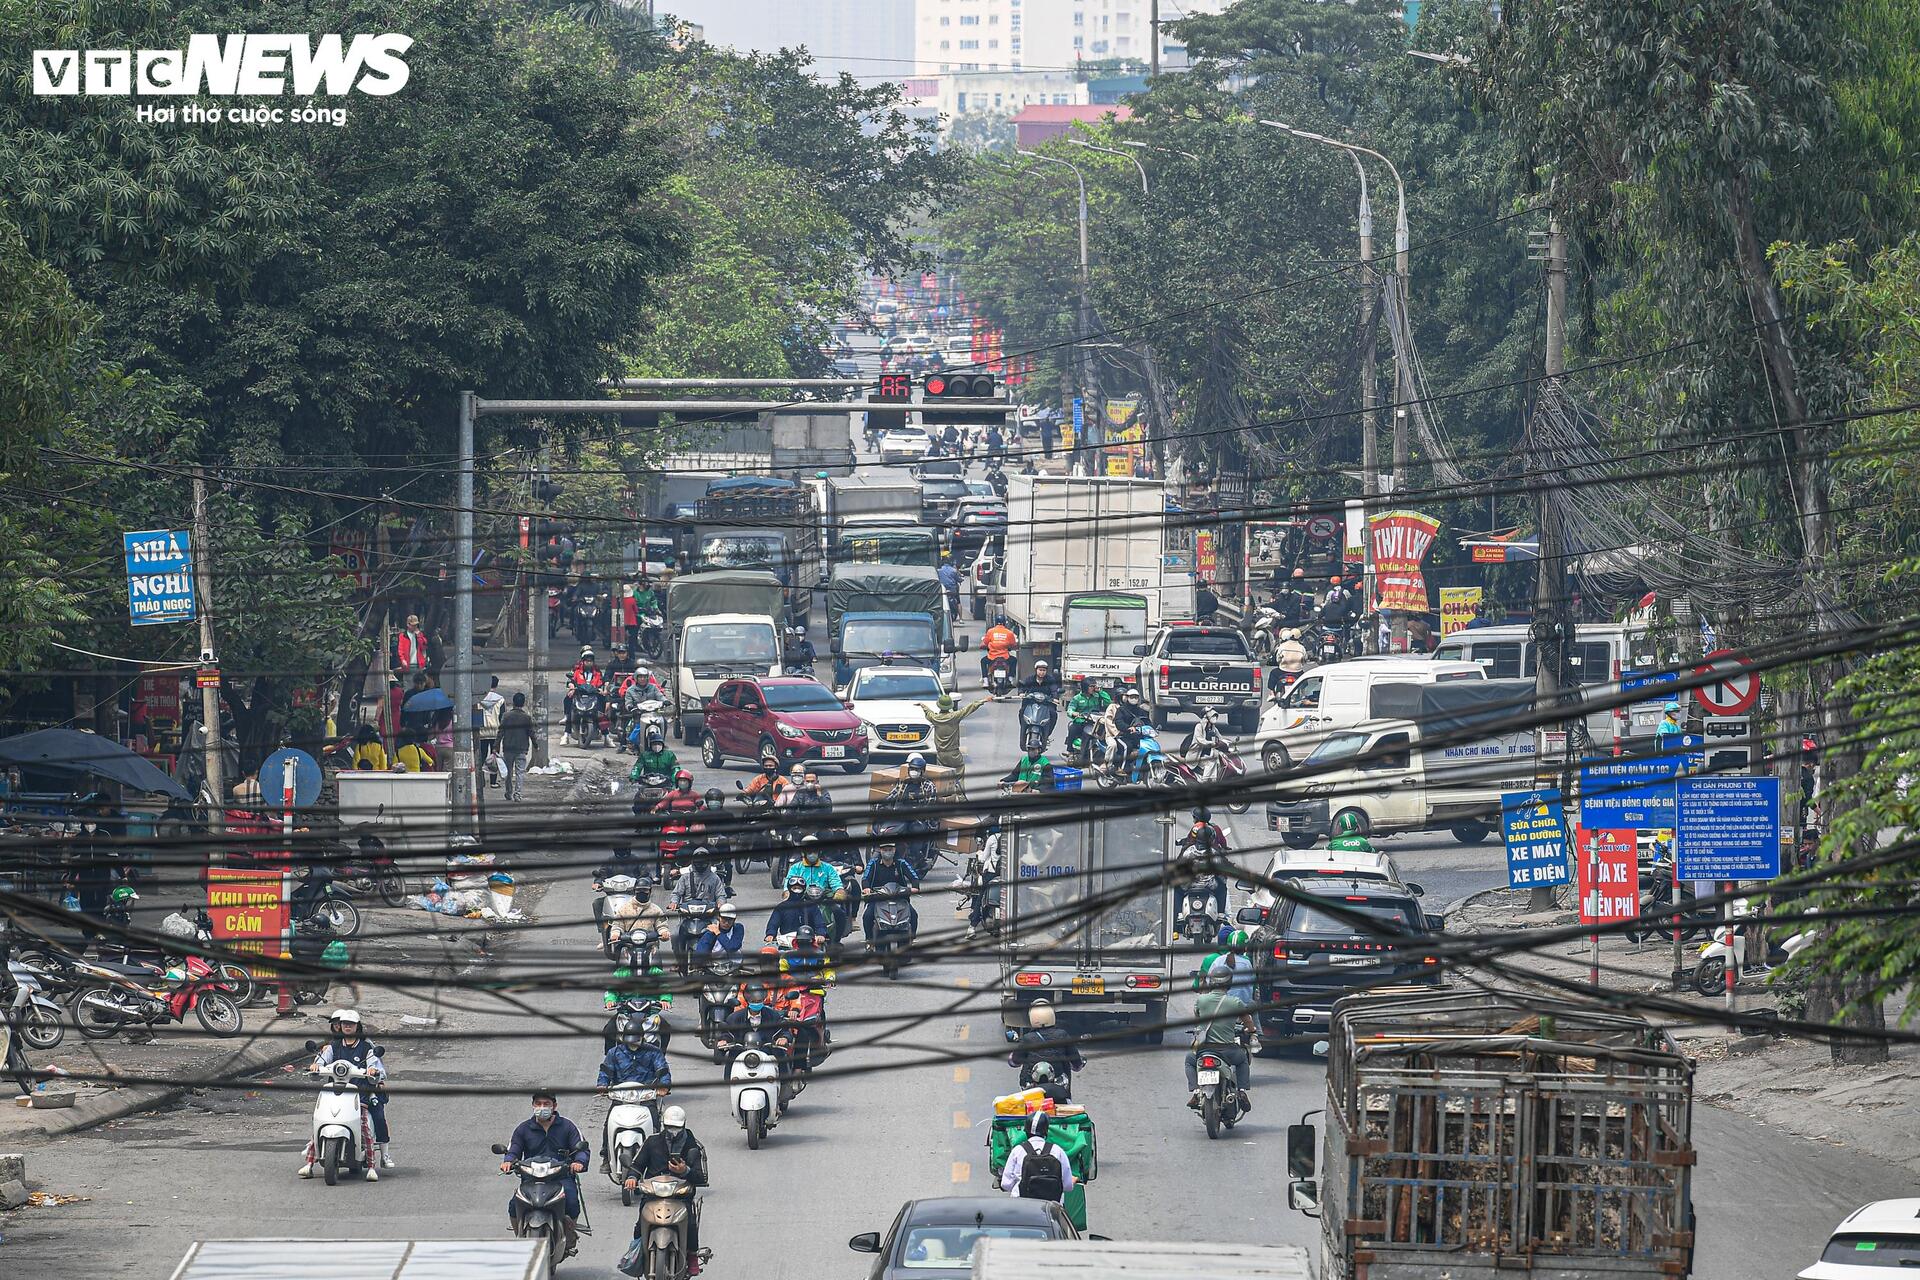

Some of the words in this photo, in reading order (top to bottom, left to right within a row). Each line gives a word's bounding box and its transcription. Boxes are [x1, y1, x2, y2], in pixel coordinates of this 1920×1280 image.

[132, 533, 184, 562] NHÀ
[131, 564, 190, 596] NGHỈ
[1109, 578, 1121, 588] 29E
[1128, 578, 1149, 588] 152.07
[133, 598, 160, 612] THẢO
[163, 599, 192, 612] NGỌC
[1171, 681, 1250, 691] COLORADO
[1445, 744, 1464, 759] NHẬN
[1481, 744, 1500, 756] HÀNG
[1519, 744, 1536, 754] 0983
[1589, 765, 1609, 775] BỆNH
[1610, 764, 1627, 775] VIỆN
[1628, 764, 1648, 775] QUÂN
[1649, 765, 1655, 774] Y
[1656, 765, 1670, 774] 103
[1743, 780, 1757, 789] TIỆN
[1585, 797, 1604, 809] BỆNH
[1604, 797, 1621, 809] VIỆN
[1642, 795, 1661, 808] QUỐC
[1662, 798, 1674, 807] GIA
[1510, 820, 1529, 830] SỬA
[1532, 818, 1557, 829] CHỮA
[1508, 832, 1527, 842] BẢO
[1530, 829, 1561, 840] DƯỠNG
[1511, 846, 1529, 861] XE
[1532, 842, 1562, 859] MÁY
[1020, 866, 1038, 877] 89H
[1513, 868, 1530, 883] XE
[1533, 863, 1566, 882] ĐIỆN
[1613, 863, 1628, 883] XE
[210, 891, 243, 908] KHU
[247, 892, 278, 912] VỰC
[1615, 893, 1634, 916] PHÍ
[225, 911, 262, 932] CẤM
[1076, 986, 1101, 994] 109.94
